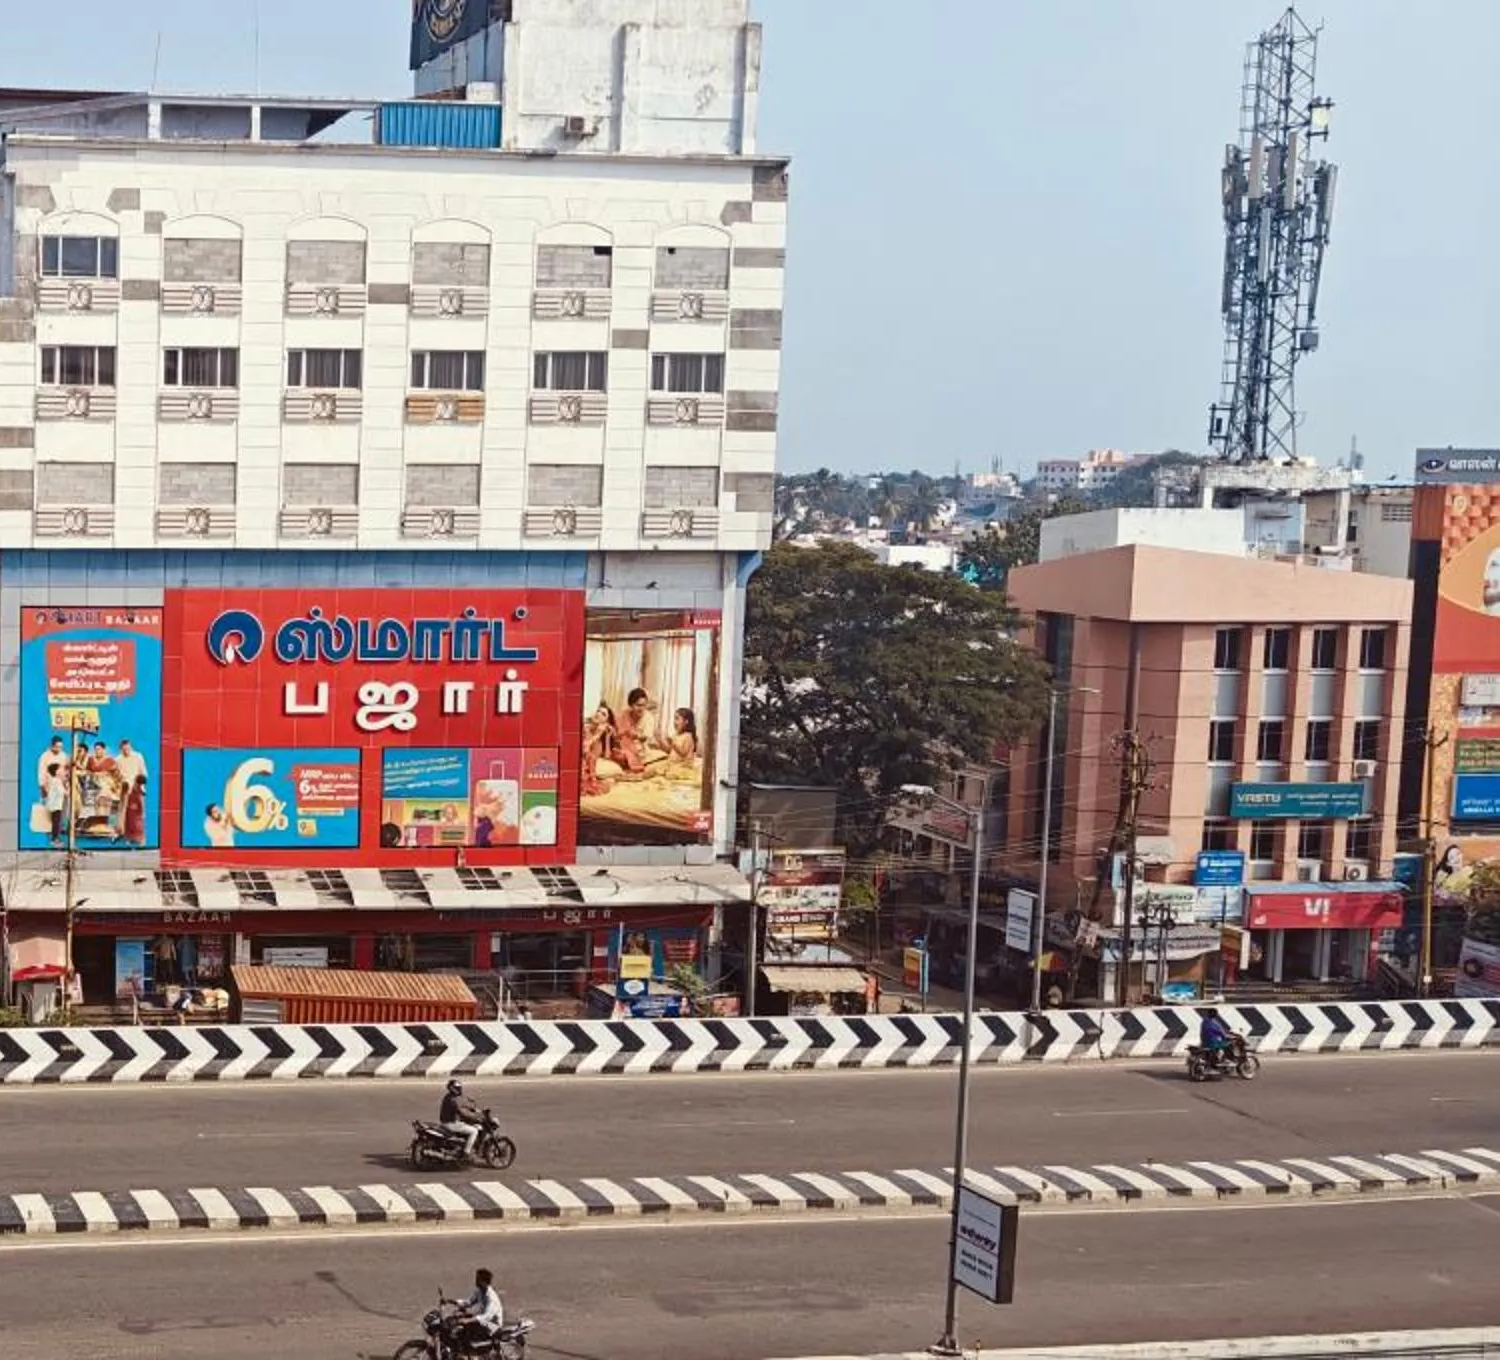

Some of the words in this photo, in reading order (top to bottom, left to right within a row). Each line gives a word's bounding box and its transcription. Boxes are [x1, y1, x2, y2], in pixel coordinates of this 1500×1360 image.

[275, 606, 539, 661] ஸ்மார்ட்
[284, 668, 529, 731] பஜார்
[224, 757, 289, 833] 6%
